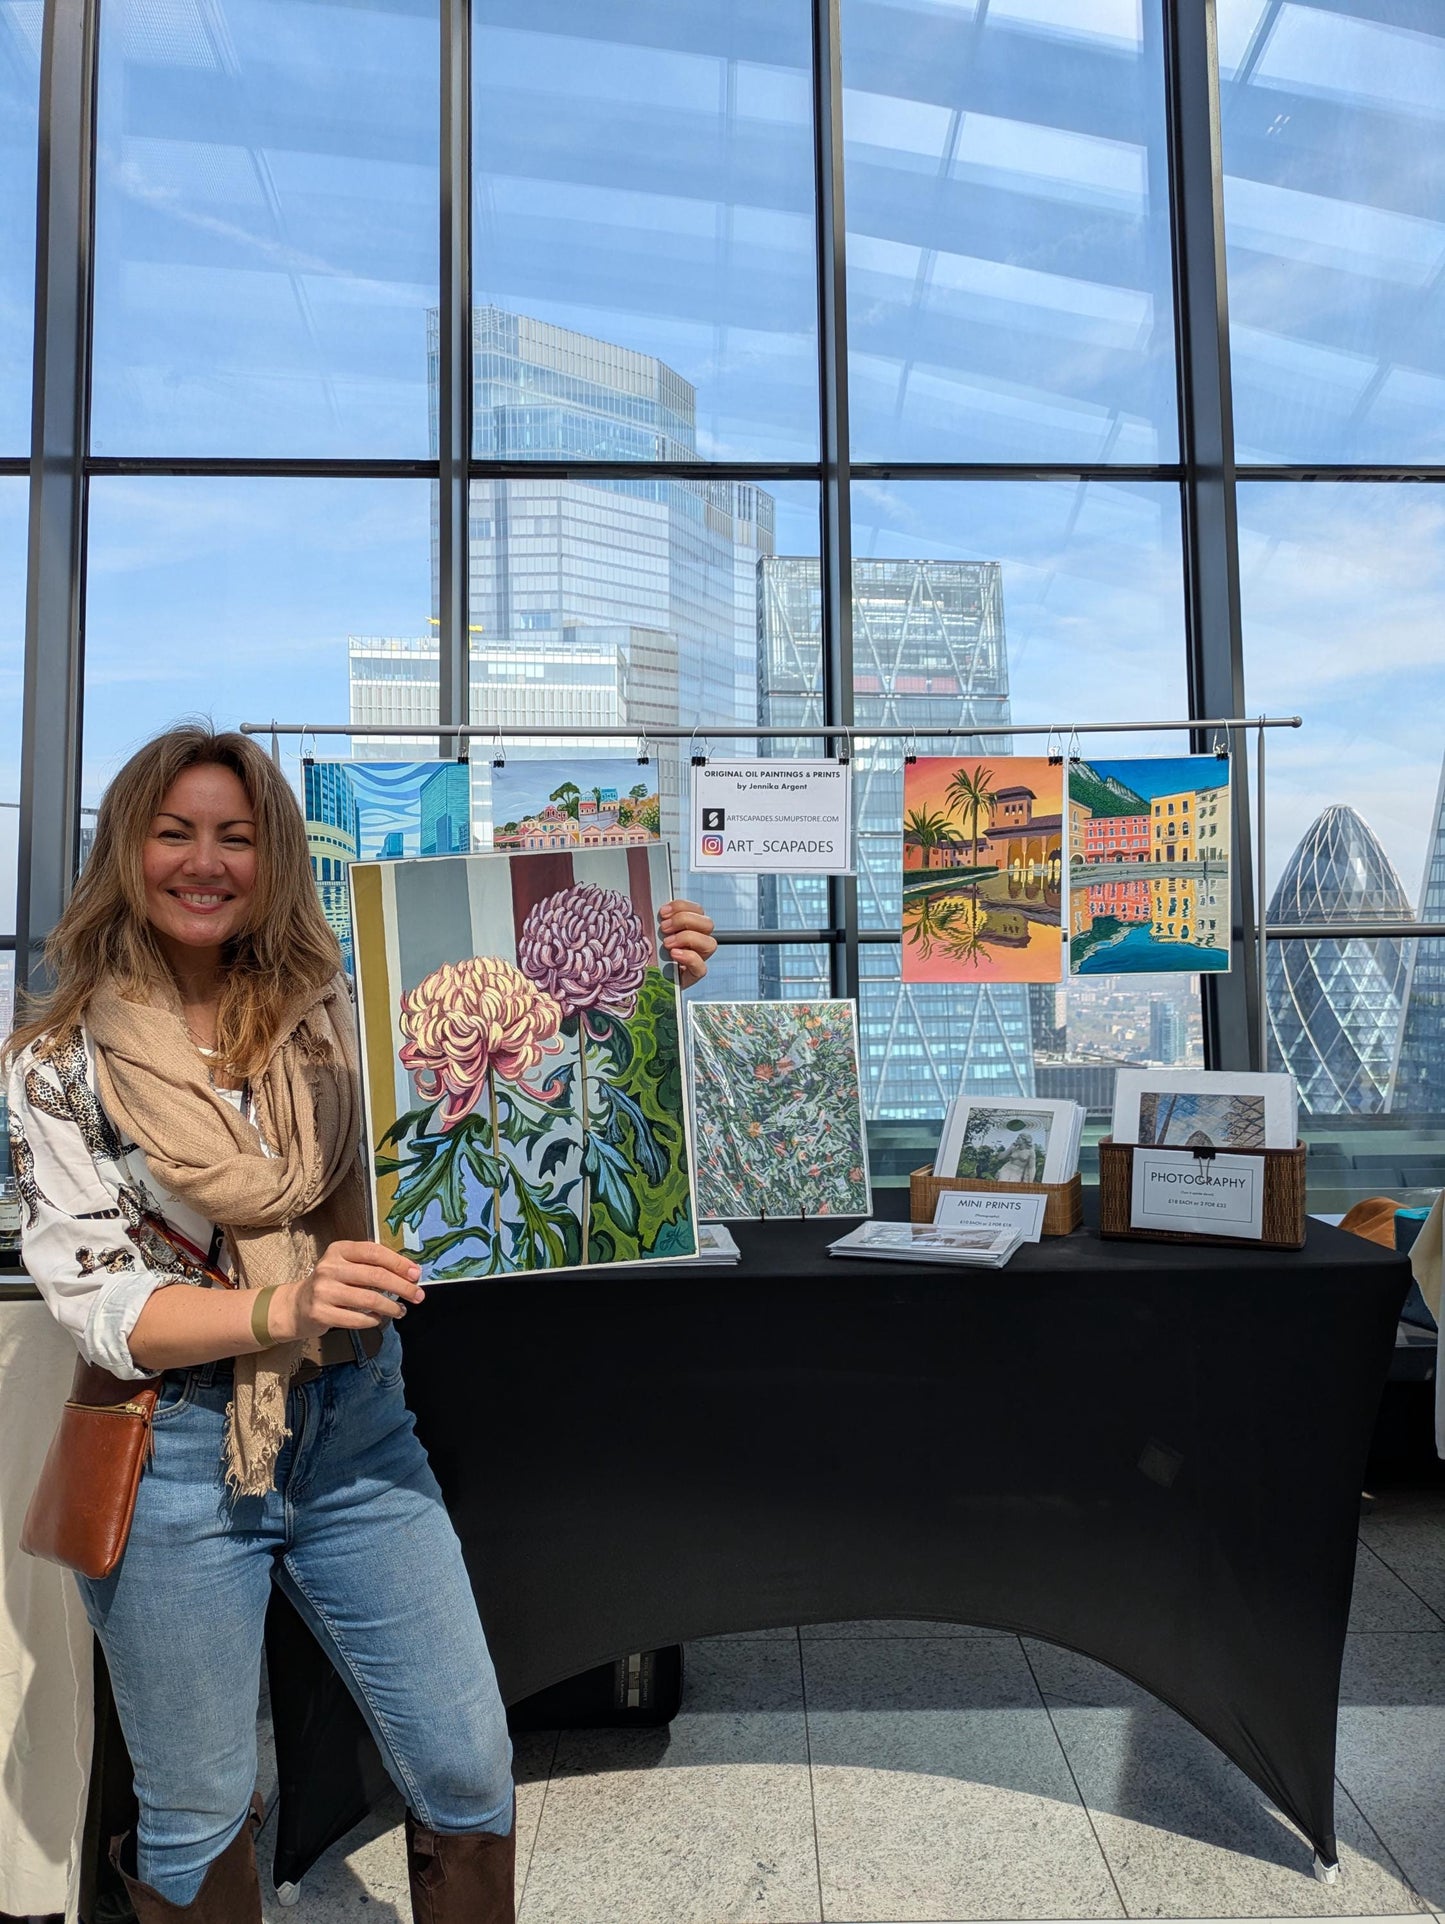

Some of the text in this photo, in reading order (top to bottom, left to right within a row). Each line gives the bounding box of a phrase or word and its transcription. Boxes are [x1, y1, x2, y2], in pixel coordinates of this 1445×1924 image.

[737, 783, 747, 791] by
[781, 783, 807, 791] Argent
[726, 815, 840, 823] ARTSCAPADES.SUMUPSTORE.COM
[726, 840, 834, 855] ART_SCAPADES
[1151, 1172, 1246, 1188] PHOTOGRAPHY
[957, 1200, 1022, 1210] MINI PRINTS
